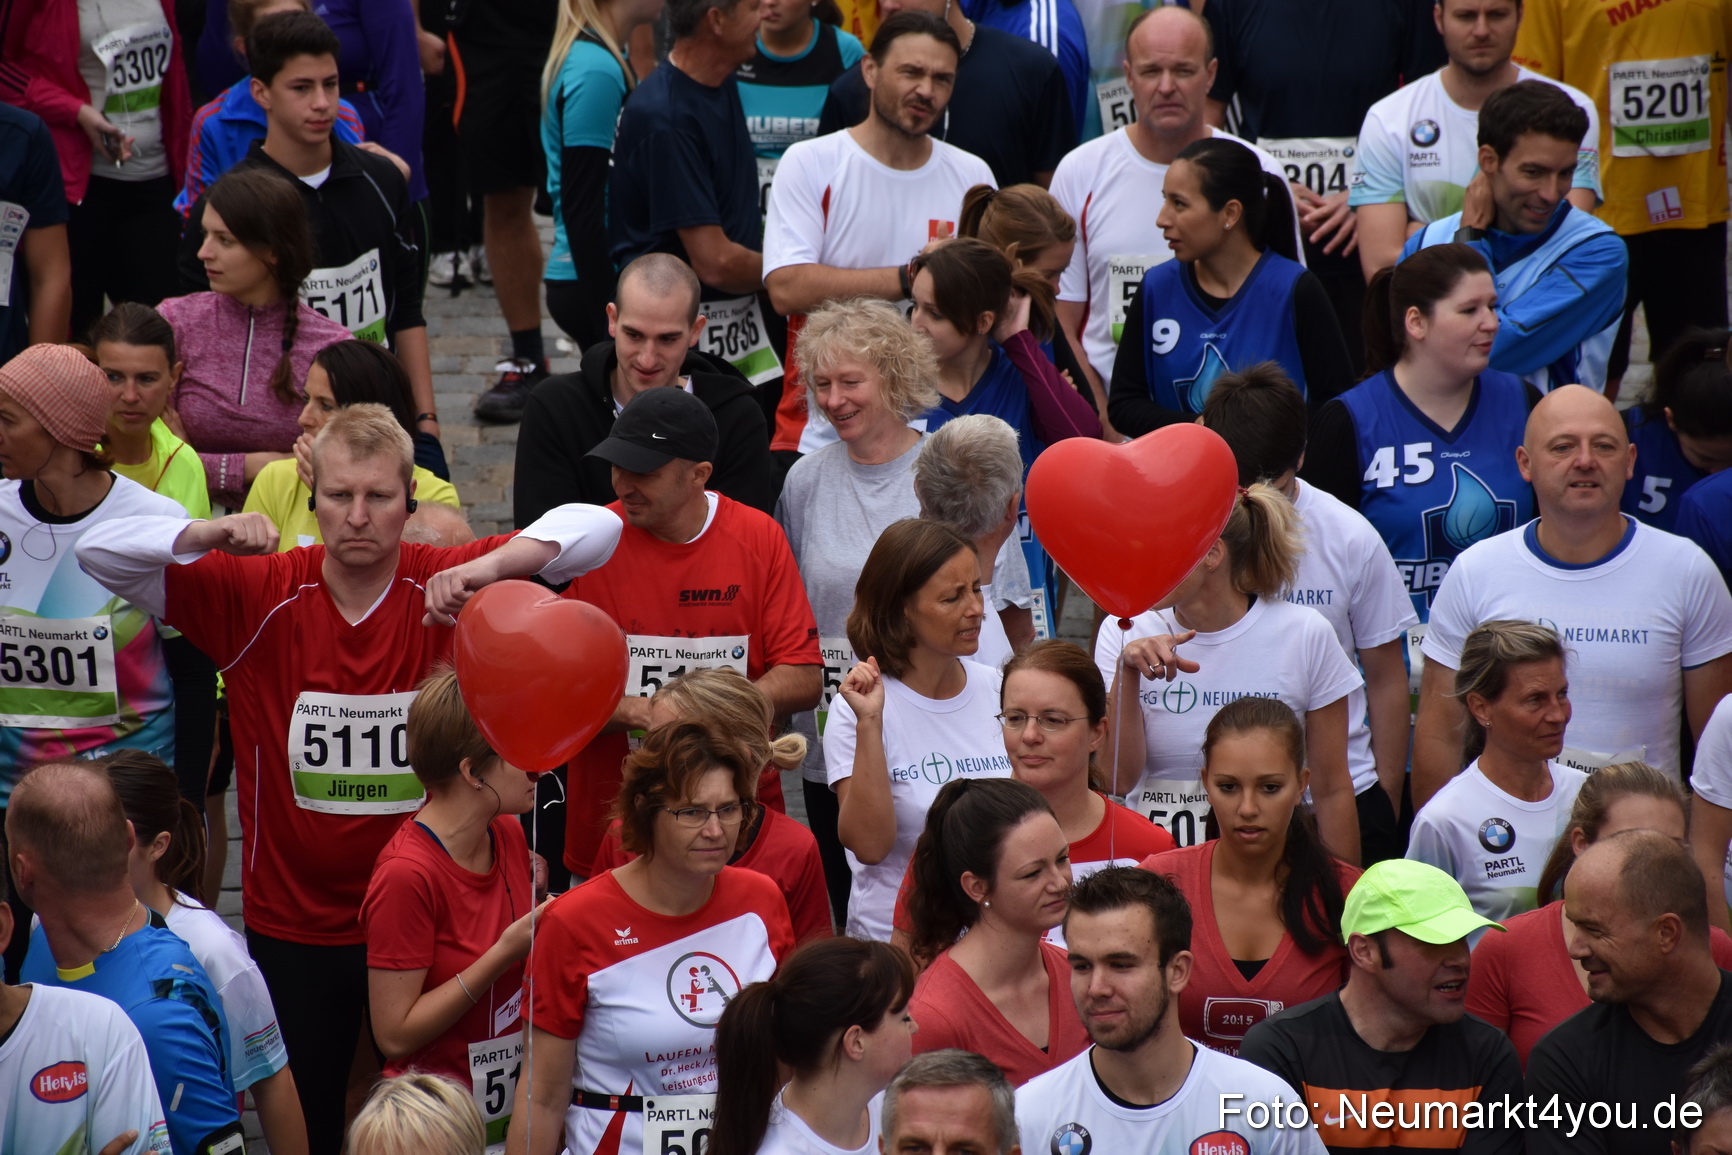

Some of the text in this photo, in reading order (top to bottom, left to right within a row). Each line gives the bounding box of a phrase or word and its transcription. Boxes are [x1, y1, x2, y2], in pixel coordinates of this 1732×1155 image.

[113, 43, 168, 88] 5302
[1612, 64, 1699, 81] PARTL Neumarkt
[1100, 87, 1129, 101] PARTL
[1623, 79, 1702, 121] 5201
[1636, 127, 1696, 144] Christian
[1287, 148, 1339, 159] Neumarkt
[1409, 153, 1441, 161] PARTL
[303, 277, 334, 292] ARTL
[1152, 318, 1181, 355] 9
[1363, 442, 1436, 489] 45
[1638, 475, 1673, 514] 5
[679, 588, 722, 602] swn
[1280, 590, 1334, 605] MARKT
[0, 625, 89, 641] ARTL Neumarkt
[1565, 628, 1650, 645] NEUMARKT
[630, 647, 728, 661] PARTL Neumarkt
[821, 649, 849, 661] ARTL
[0, 643, 98, 687] 5301
[296, 703, 403, 719] PARTL Neumarkt
[303, 723, 411, 769] 5110
[892, 755, 1012, 783] FeG NEUMARK
[327, 780, 388, 802] Jürgen
[1142, 791, 1177, 804] PARTL
[1485, 856, 1524, 873] PARTL
[1487, 866, 1526, 881] Neumarkt
[614, 936, 639, 946] erima
[1222, 1014, 1255, 1026] 20:15
[473, 1050, 513, 1068] PARTL
[661, 1067, 676, 1077] Dr.
[677, 1060, 701, 1073] Heck
[39, 1071, 87, 1094] Hervis
[662, 1070, 718, 1092] Leistungsdi
[647, 1109, 695, 1122] PARTL
